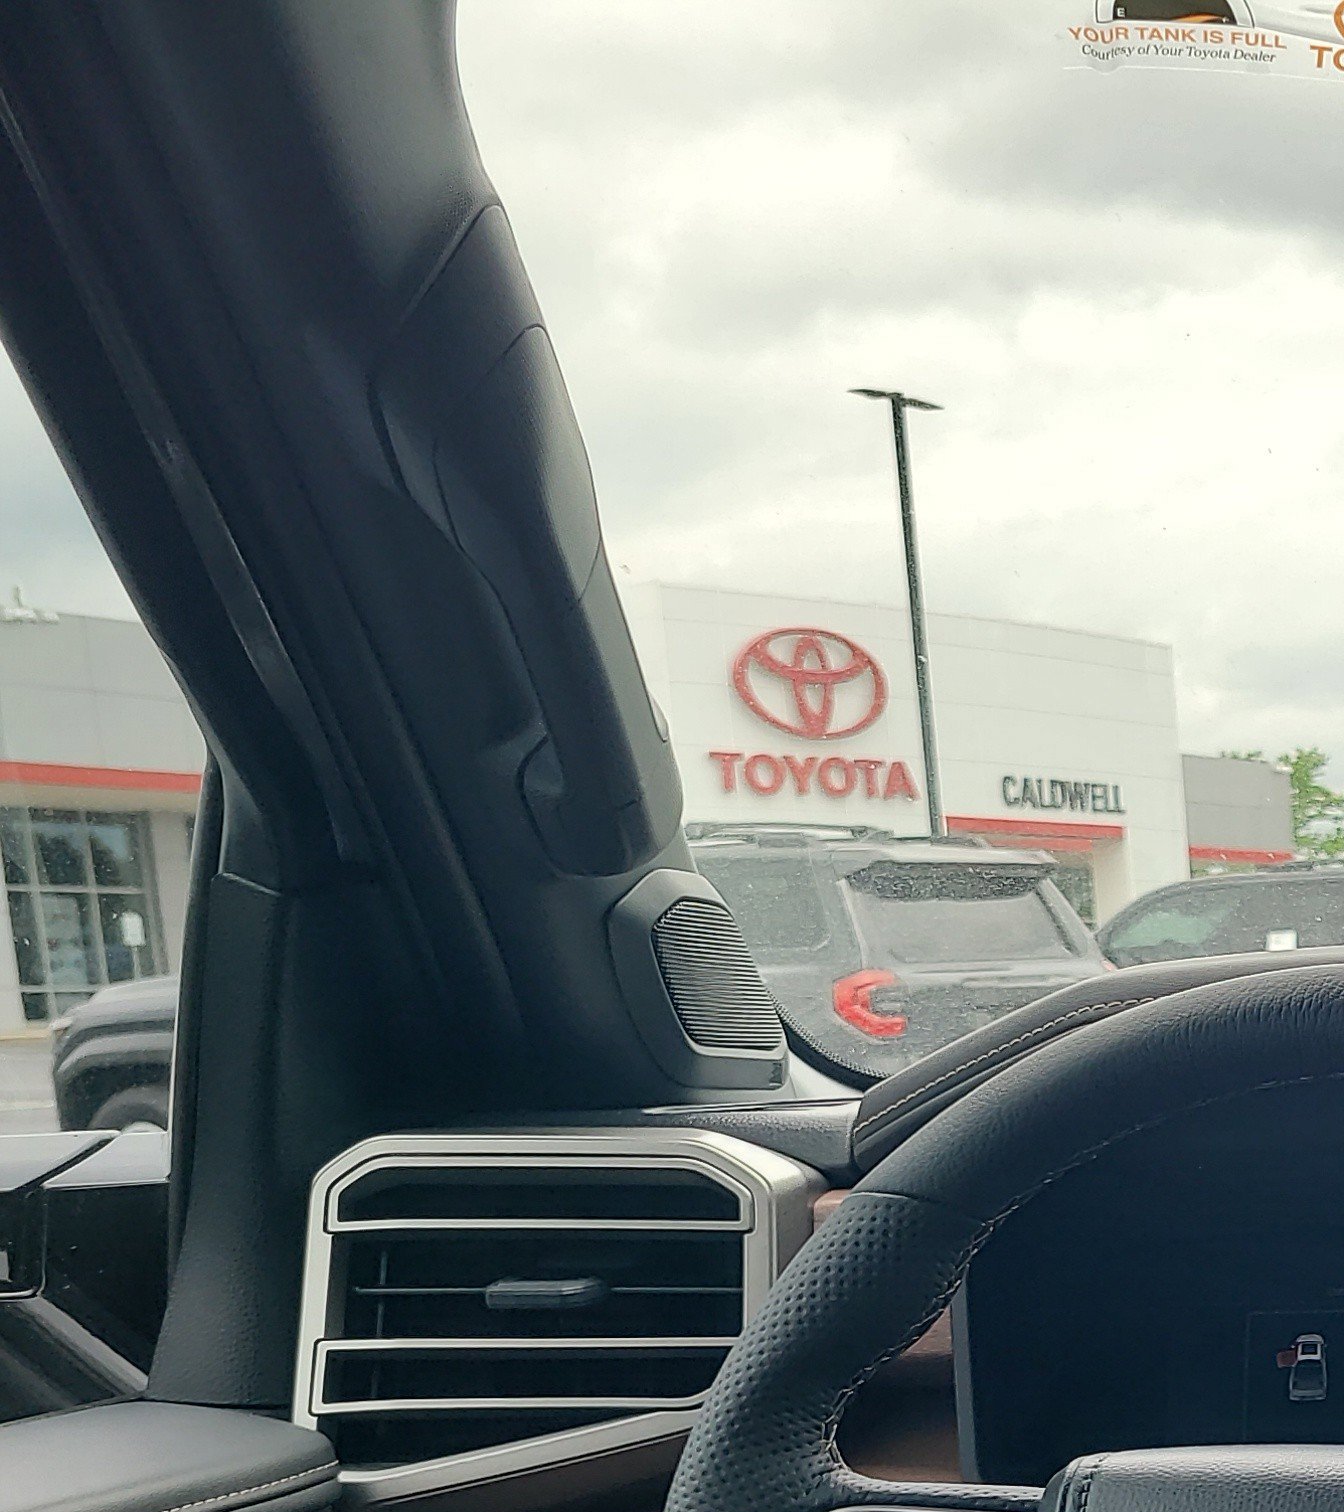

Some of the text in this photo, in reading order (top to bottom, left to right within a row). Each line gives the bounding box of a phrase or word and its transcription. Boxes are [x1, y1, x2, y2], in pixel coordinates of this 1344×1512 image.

[1068, 26, 1288, 49] YOUR TANK IS FULL
[1082, 44, 1277, 63] Courtesy of Your Toyota Dealer
[709, 752, 920, 801] TOYOTA
[1002, 775, 1126, 814] CALDWELL
